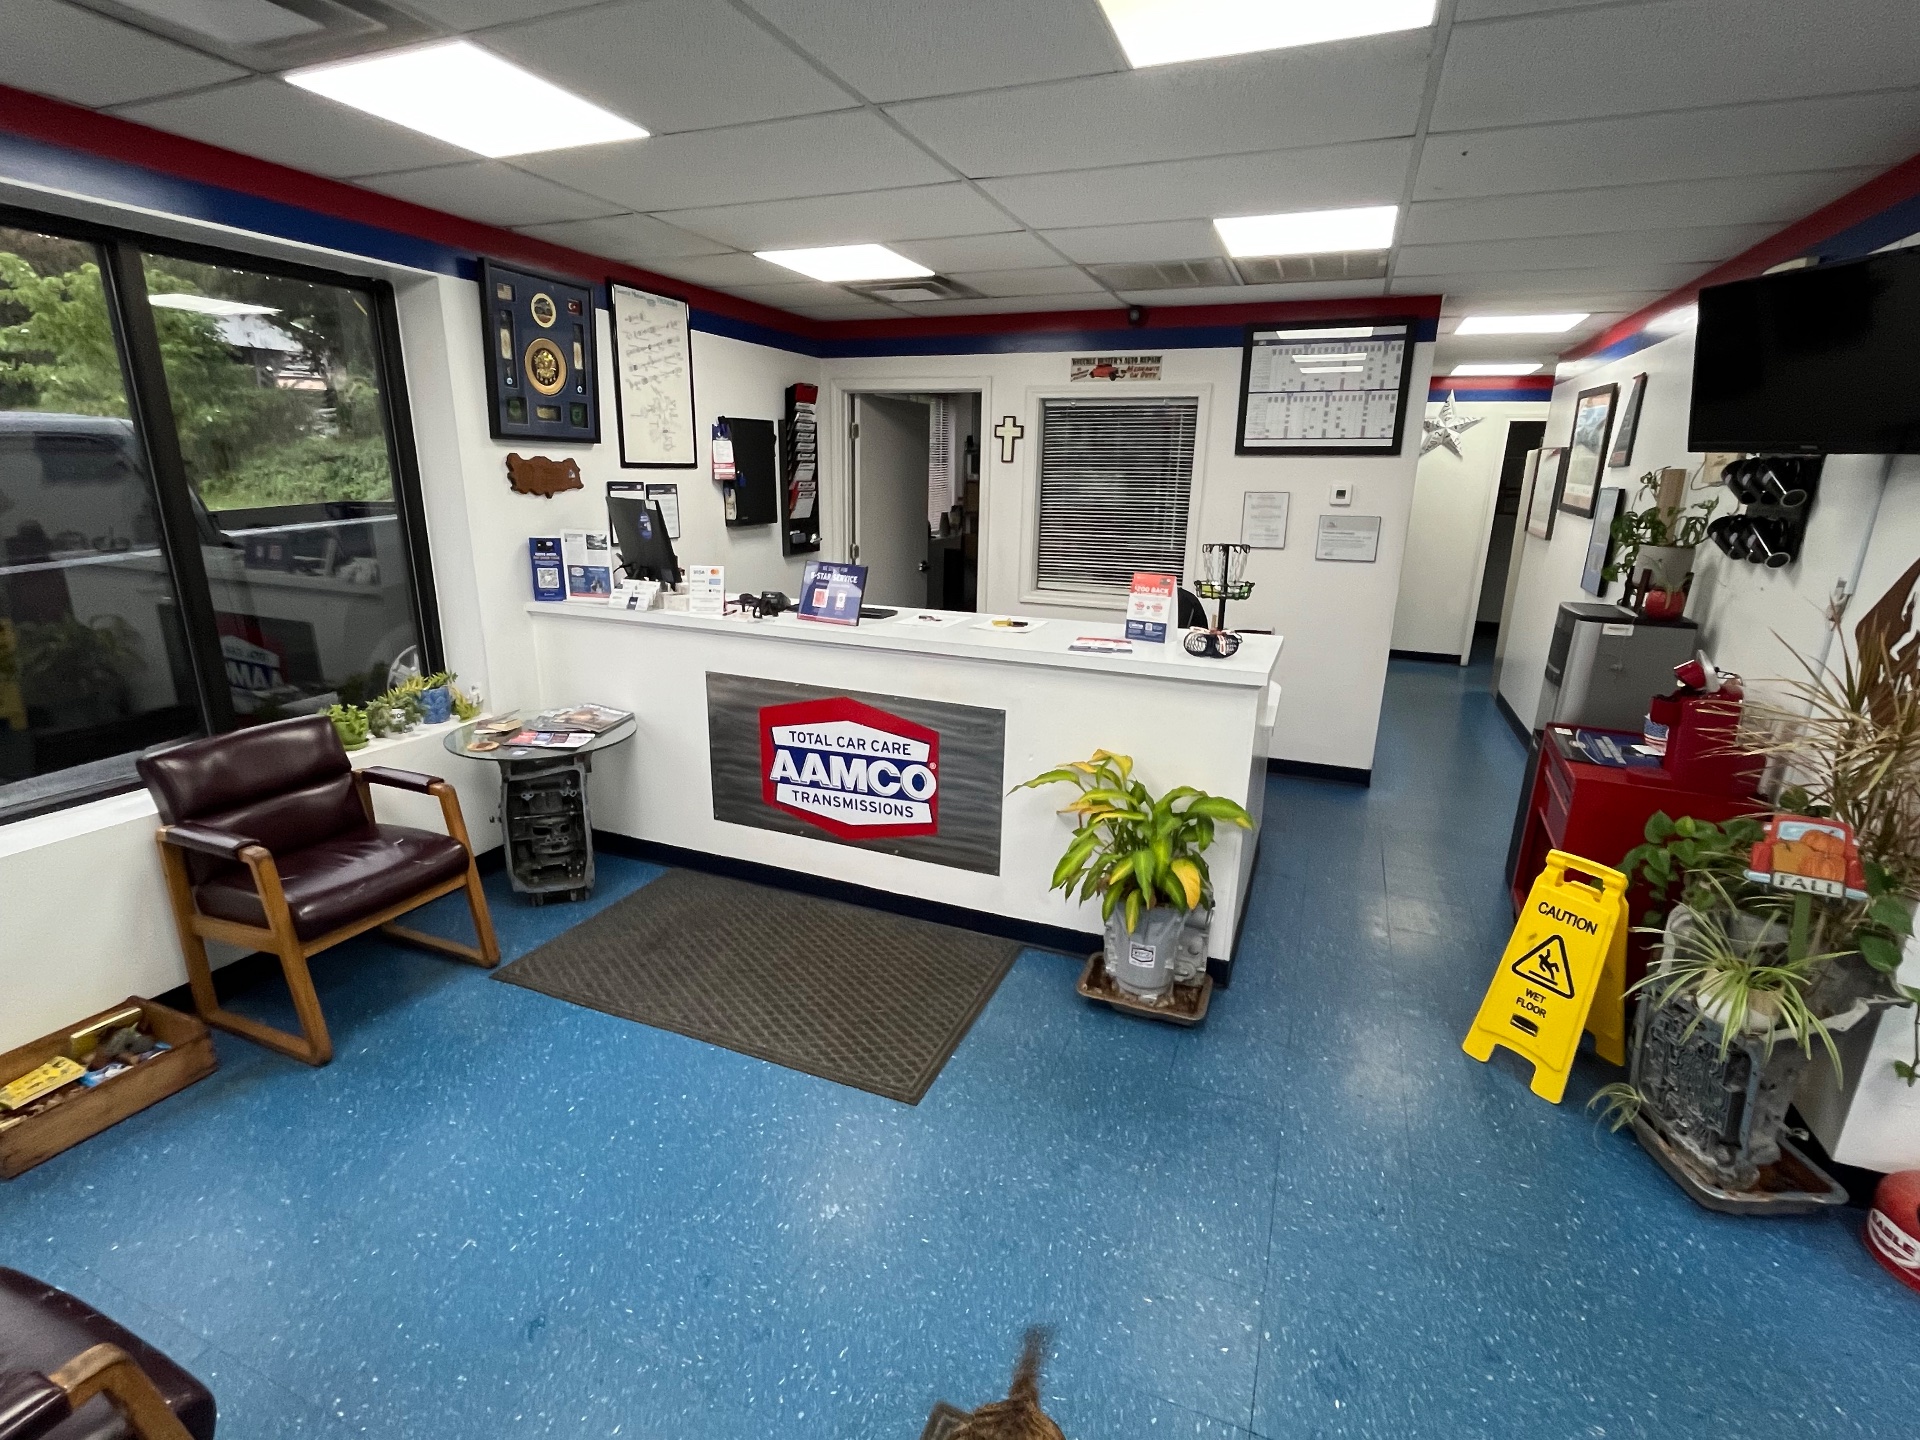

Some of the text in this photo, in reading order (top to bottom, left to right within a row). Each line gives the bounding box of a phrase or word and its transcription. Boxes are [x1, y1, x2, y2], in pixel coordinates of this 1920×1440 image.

[832, 573, 858, 584] SERVICE
[788, 730, 912, 756] TOTAL CAR CARE
[769, 748, 937, 801] AAMCO
[791, 789, 914, 818] TRANSMISSIONS
[1778, 874, 1842, 896] FALL
[1538, 901, 1599, 936] CAUTION
[1515, 996, 1547, 1019] FLOOR
[1525, 987, 1547, 1004] WET
